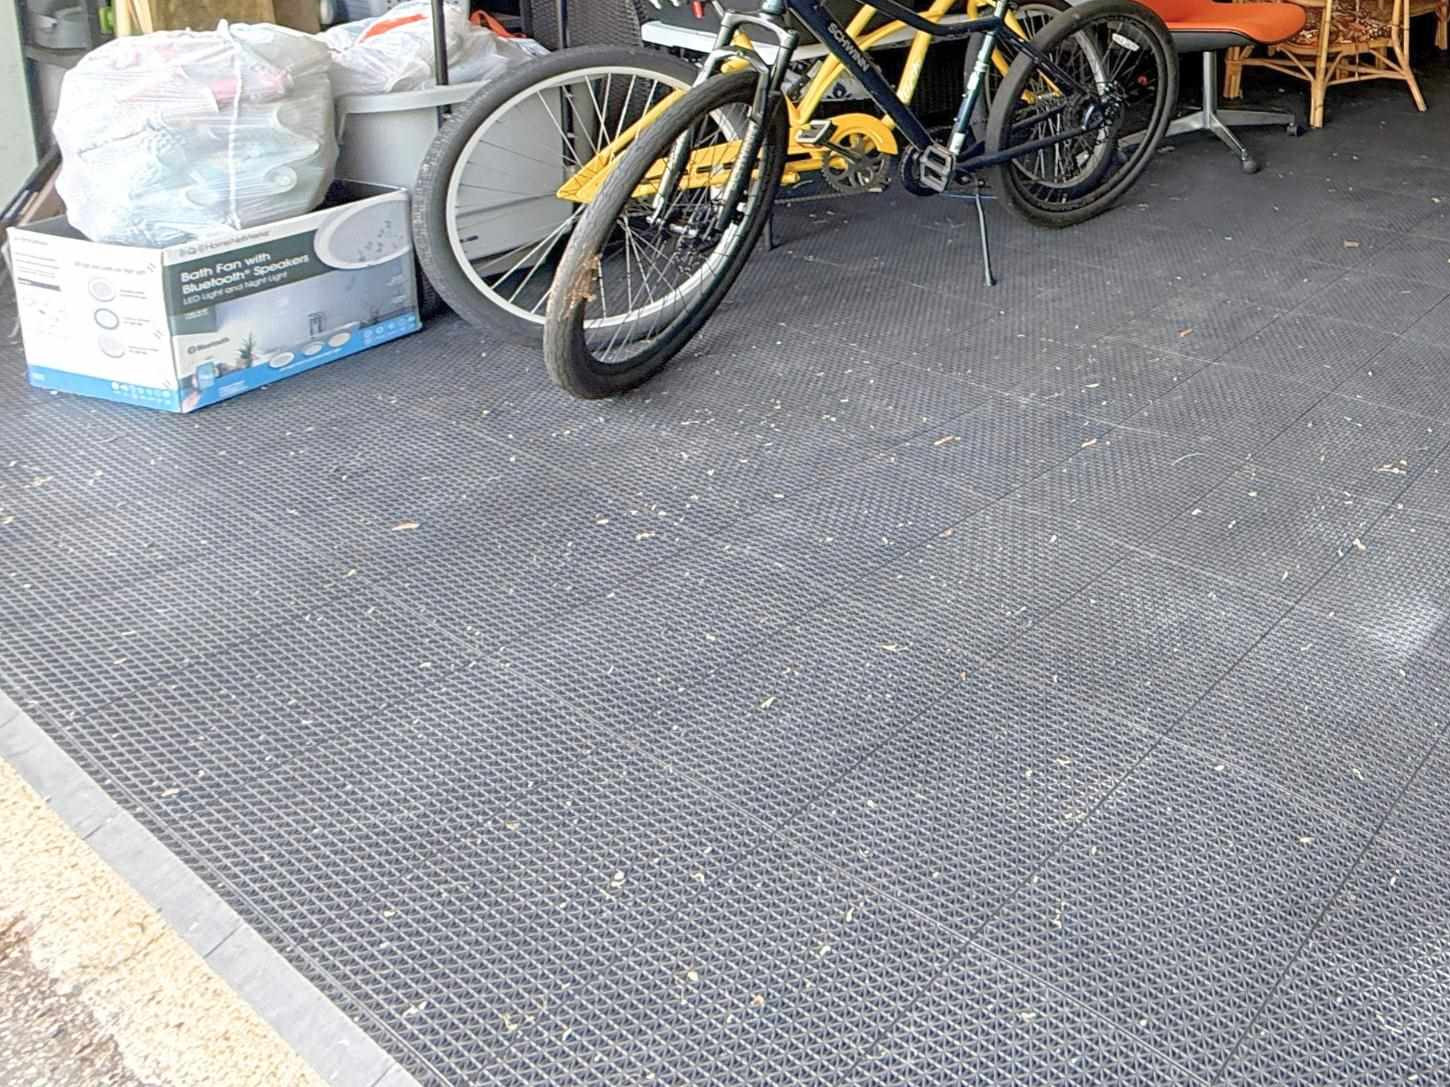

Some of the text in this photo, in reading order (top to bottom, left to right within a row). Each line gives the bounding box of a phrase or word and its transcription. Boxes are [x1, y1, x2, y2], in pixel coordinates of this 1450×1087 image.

[827, 22, 870, 72] SCHWINN
[180, 252, 271, 283] Bath Fan with
[253, 254, 309, 276] Speakers
[183, 294, 200, 305] LED
[225, 284, 243, 294] and
[268, 270, 288, 282] Light
